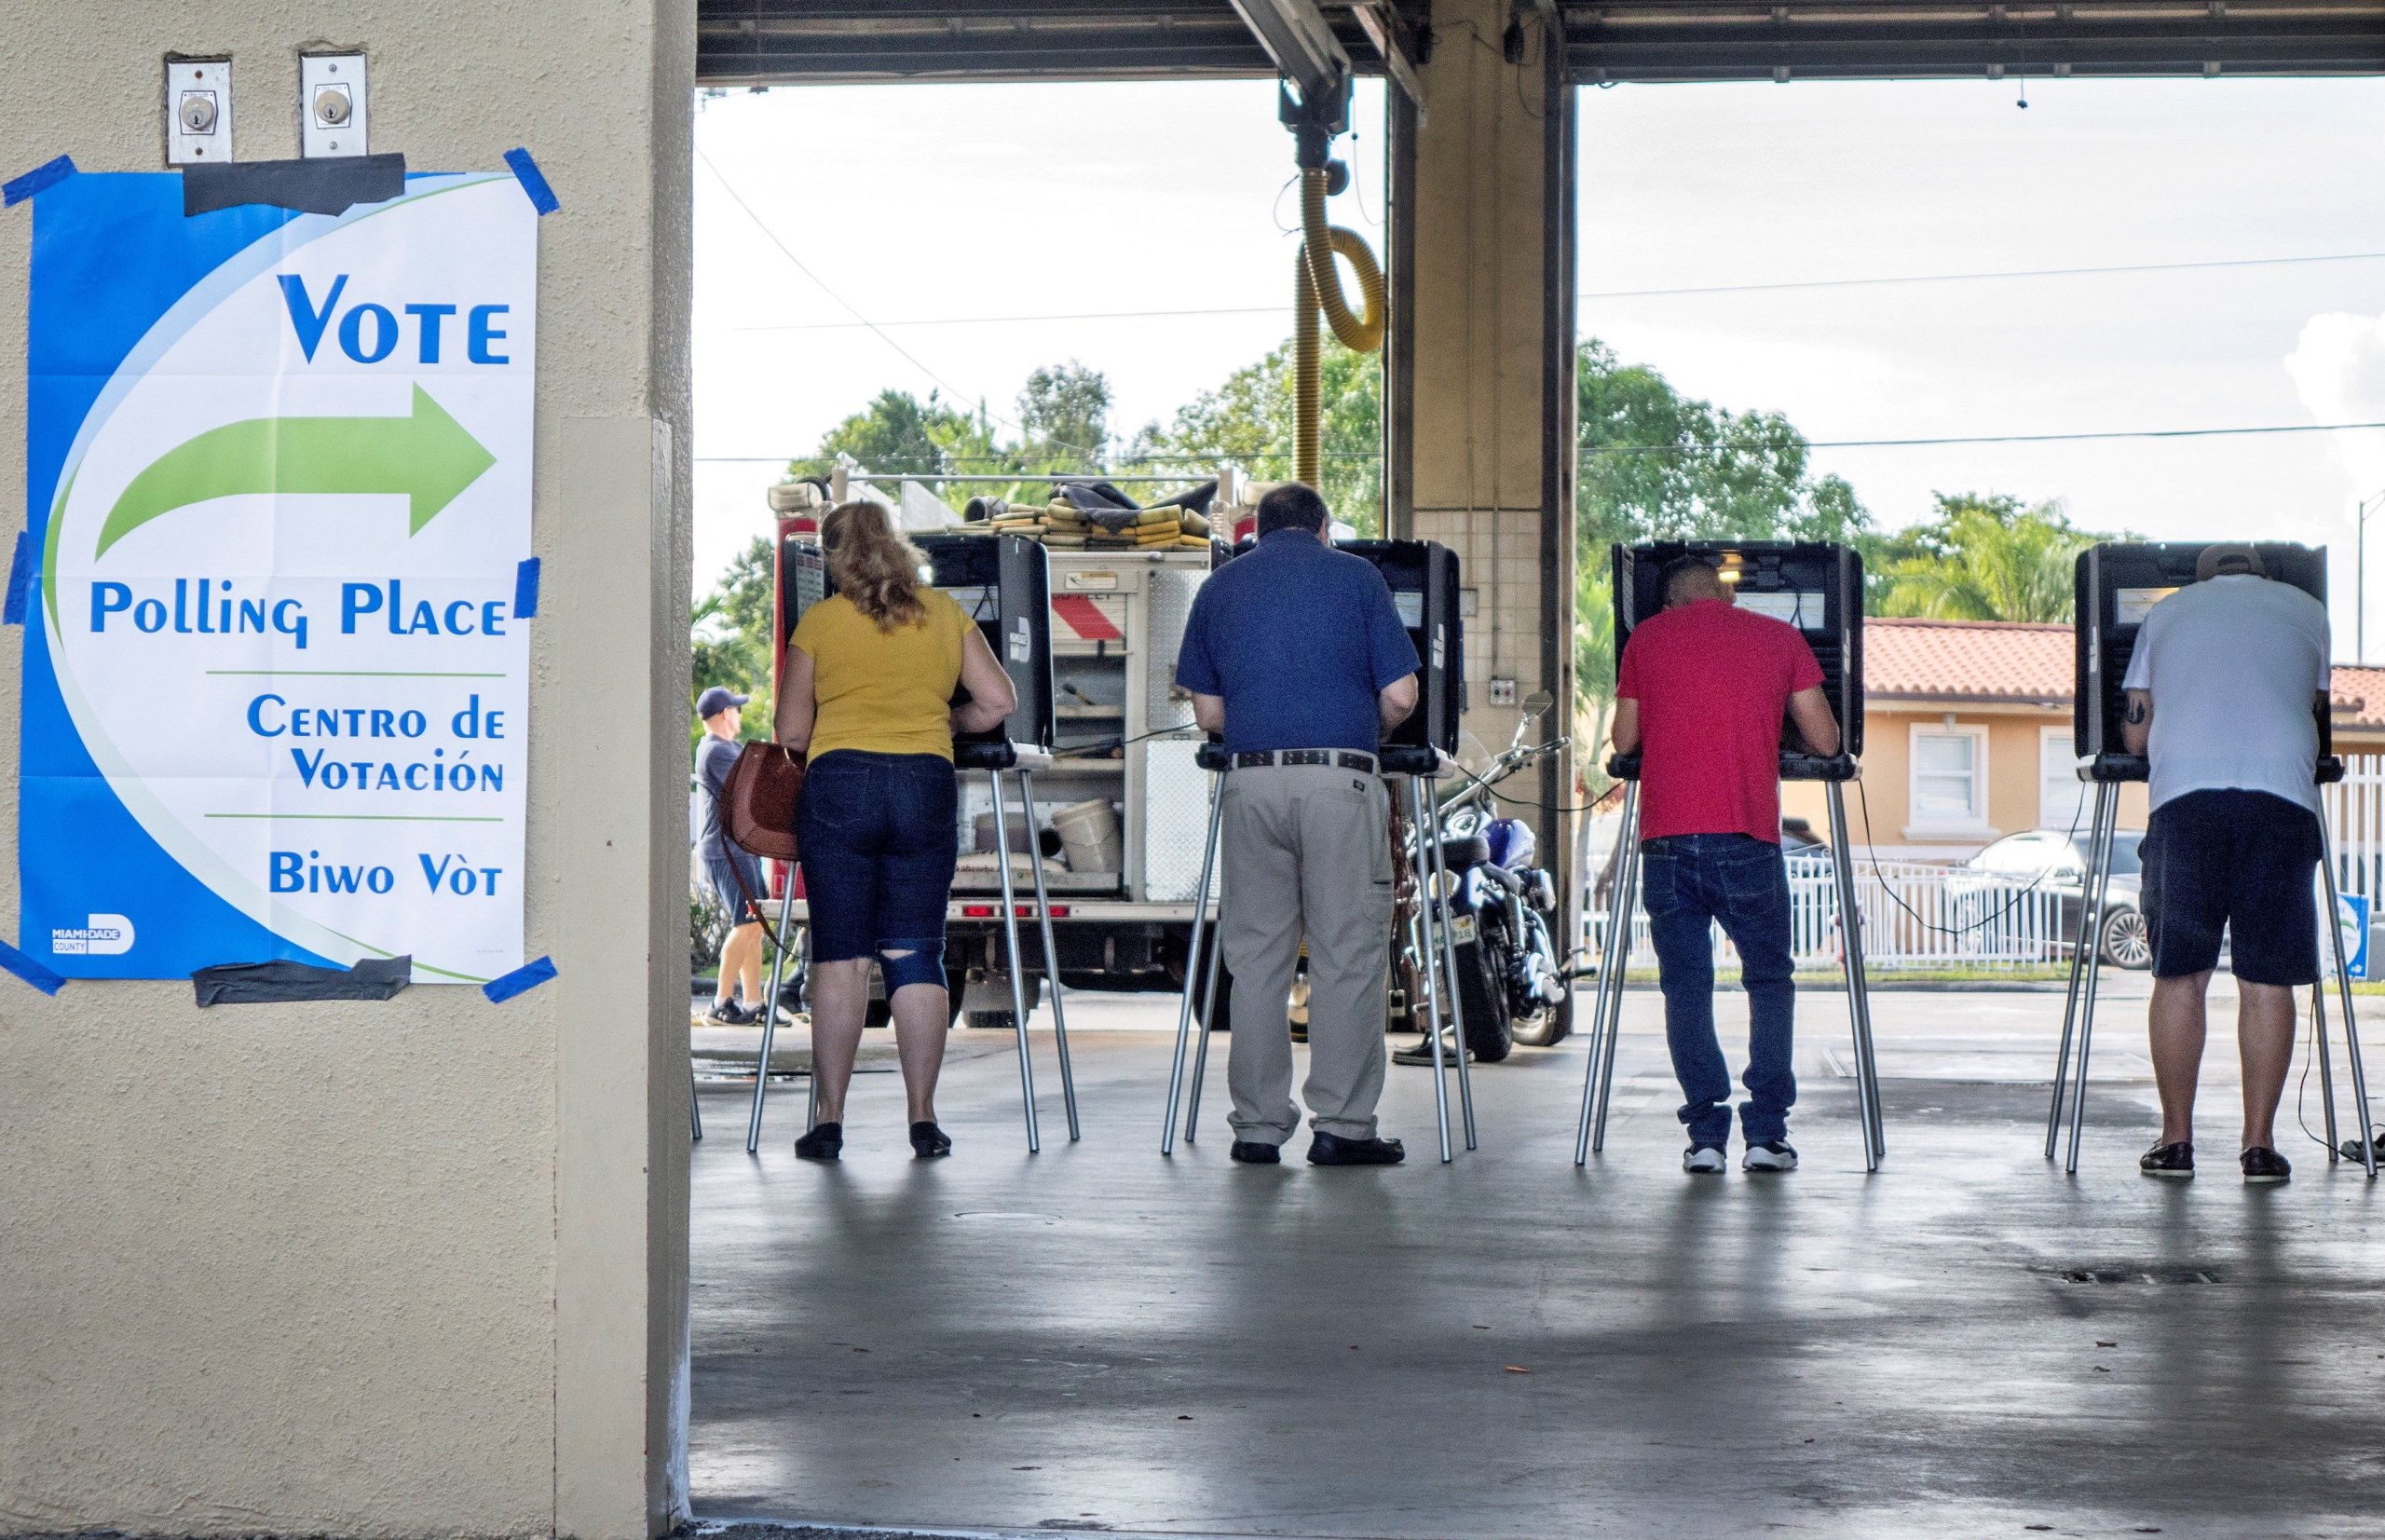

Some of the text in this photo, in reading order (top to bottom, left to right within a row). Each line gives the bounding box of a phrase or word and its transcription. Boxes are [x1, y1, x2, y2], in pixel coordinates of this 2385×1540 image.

[277, 274, 510, 365] VOTE
[90, 579, 507, 649] Polling Place
[452, 693, 505, 740] de
[269, 850, 395, 894] Biwo
[54, 942, 85, 951] COUNTY
